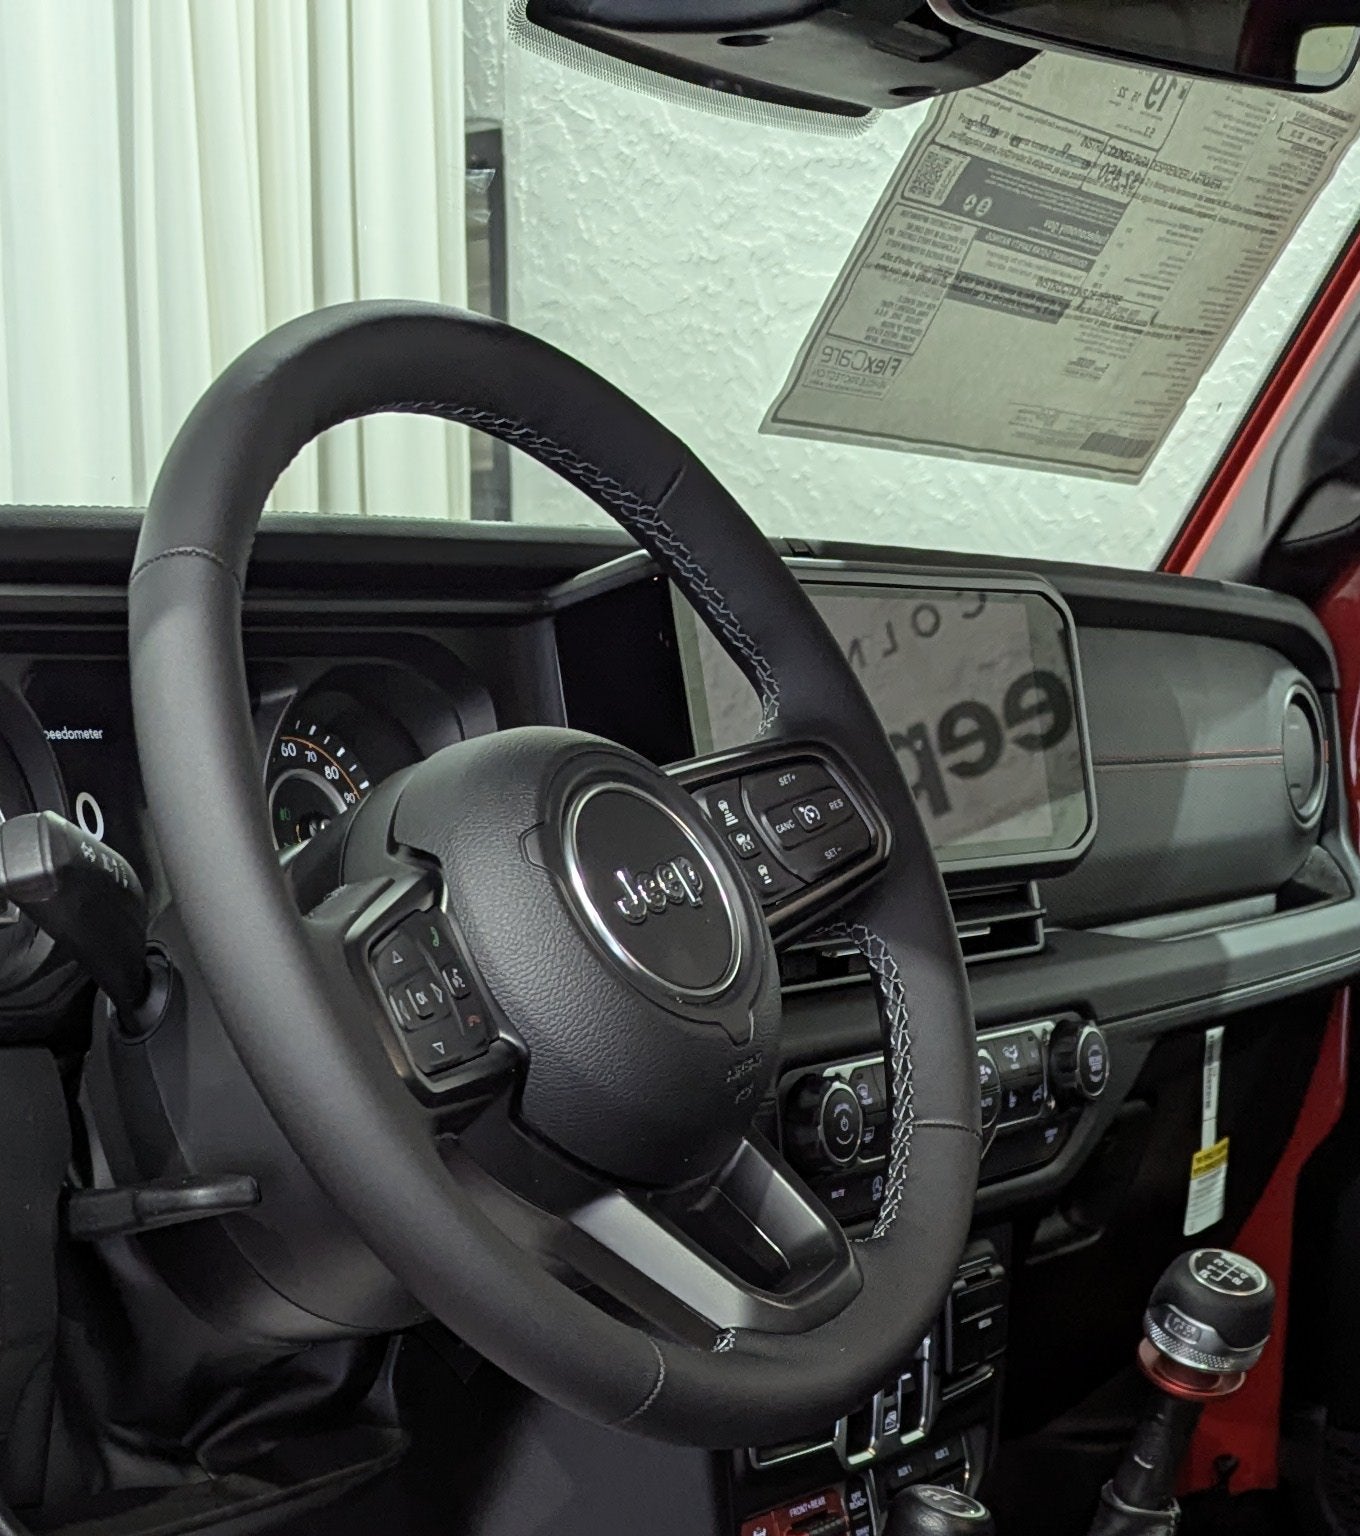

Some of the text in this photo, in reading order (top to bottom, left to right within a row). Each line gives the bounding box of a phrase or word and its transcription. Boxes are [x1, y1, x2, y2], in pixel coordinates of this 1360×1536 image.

[280, 742, 297, 757] 60
[305, 750, 317, 763] 70
[324, 766, 339, 780] 80
[343, 792, 356, 804] 90
[828, 798, 844, 811] RES
[76, 792, 105, 842] 0
[776, 819, 796, 834] CANC
[613, 856, 703, 925] Jeep
